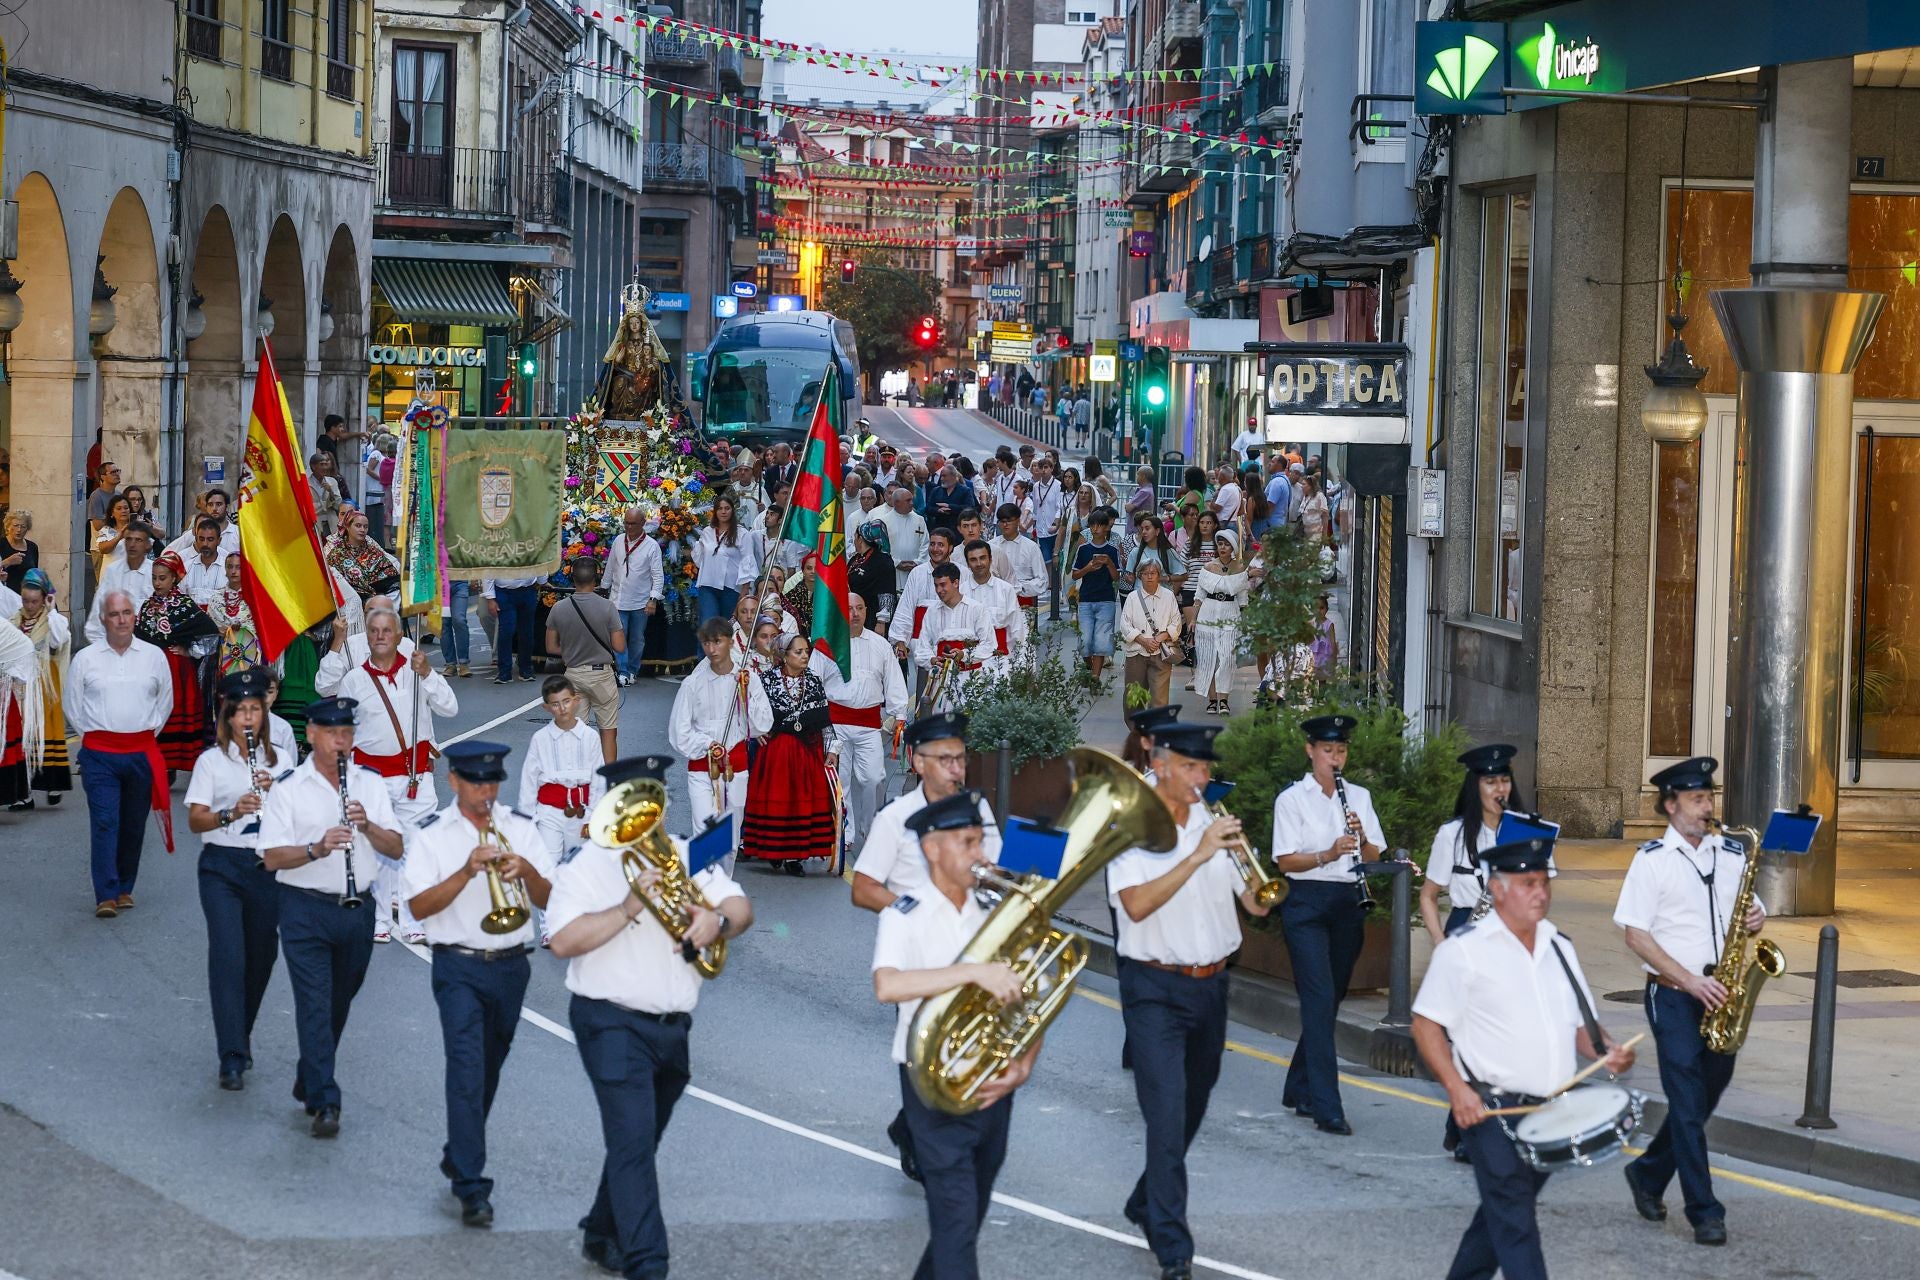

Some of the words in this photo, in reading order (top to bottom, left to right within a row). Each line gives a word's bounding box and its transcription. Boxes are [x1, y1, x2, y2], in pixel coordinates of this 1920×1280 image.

[1555, 36, 1599, 85] Unicaja
[1863, 159, 1878, 174] 27
[991, 288, 1021, 297] BUENO
[368, 345, 487, 367] COVADONGA
[1273, 364, 1400, 403] OPTICA
[596, 467, 606, 485] AVE
